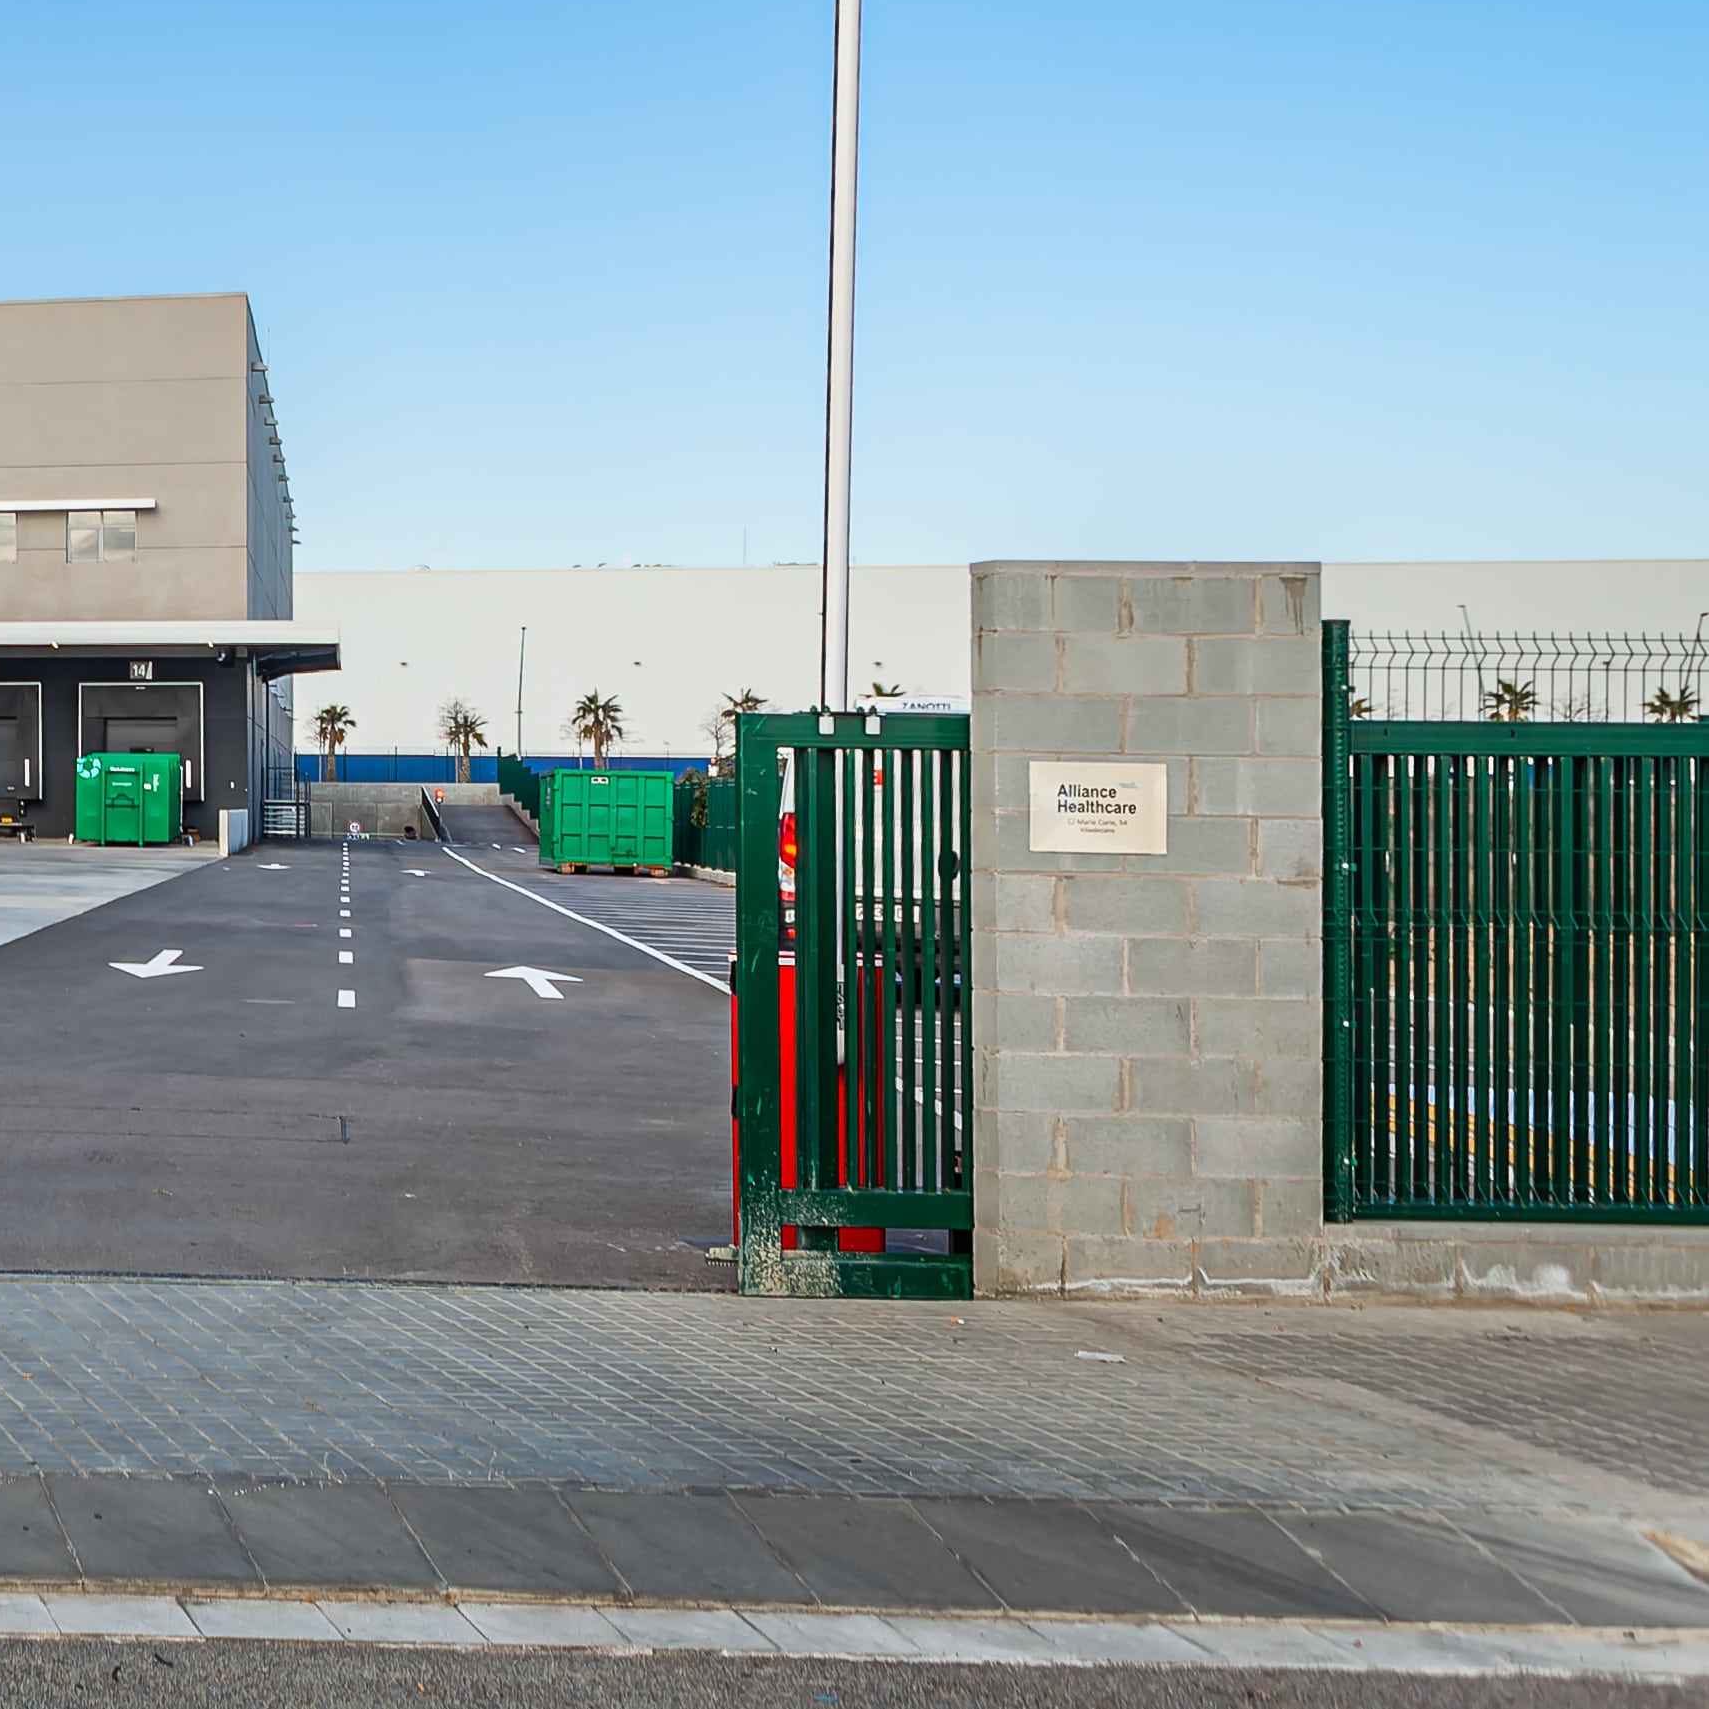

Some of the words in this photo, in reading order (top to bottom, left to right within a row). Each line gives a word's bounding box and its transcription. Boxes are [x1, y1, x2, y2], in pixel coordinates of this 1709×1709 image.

[132, 664, 146, 677] 14
[1057, 783, 1117, 799] Alliance
[1057, 799, 1137, 815] Healthcare
